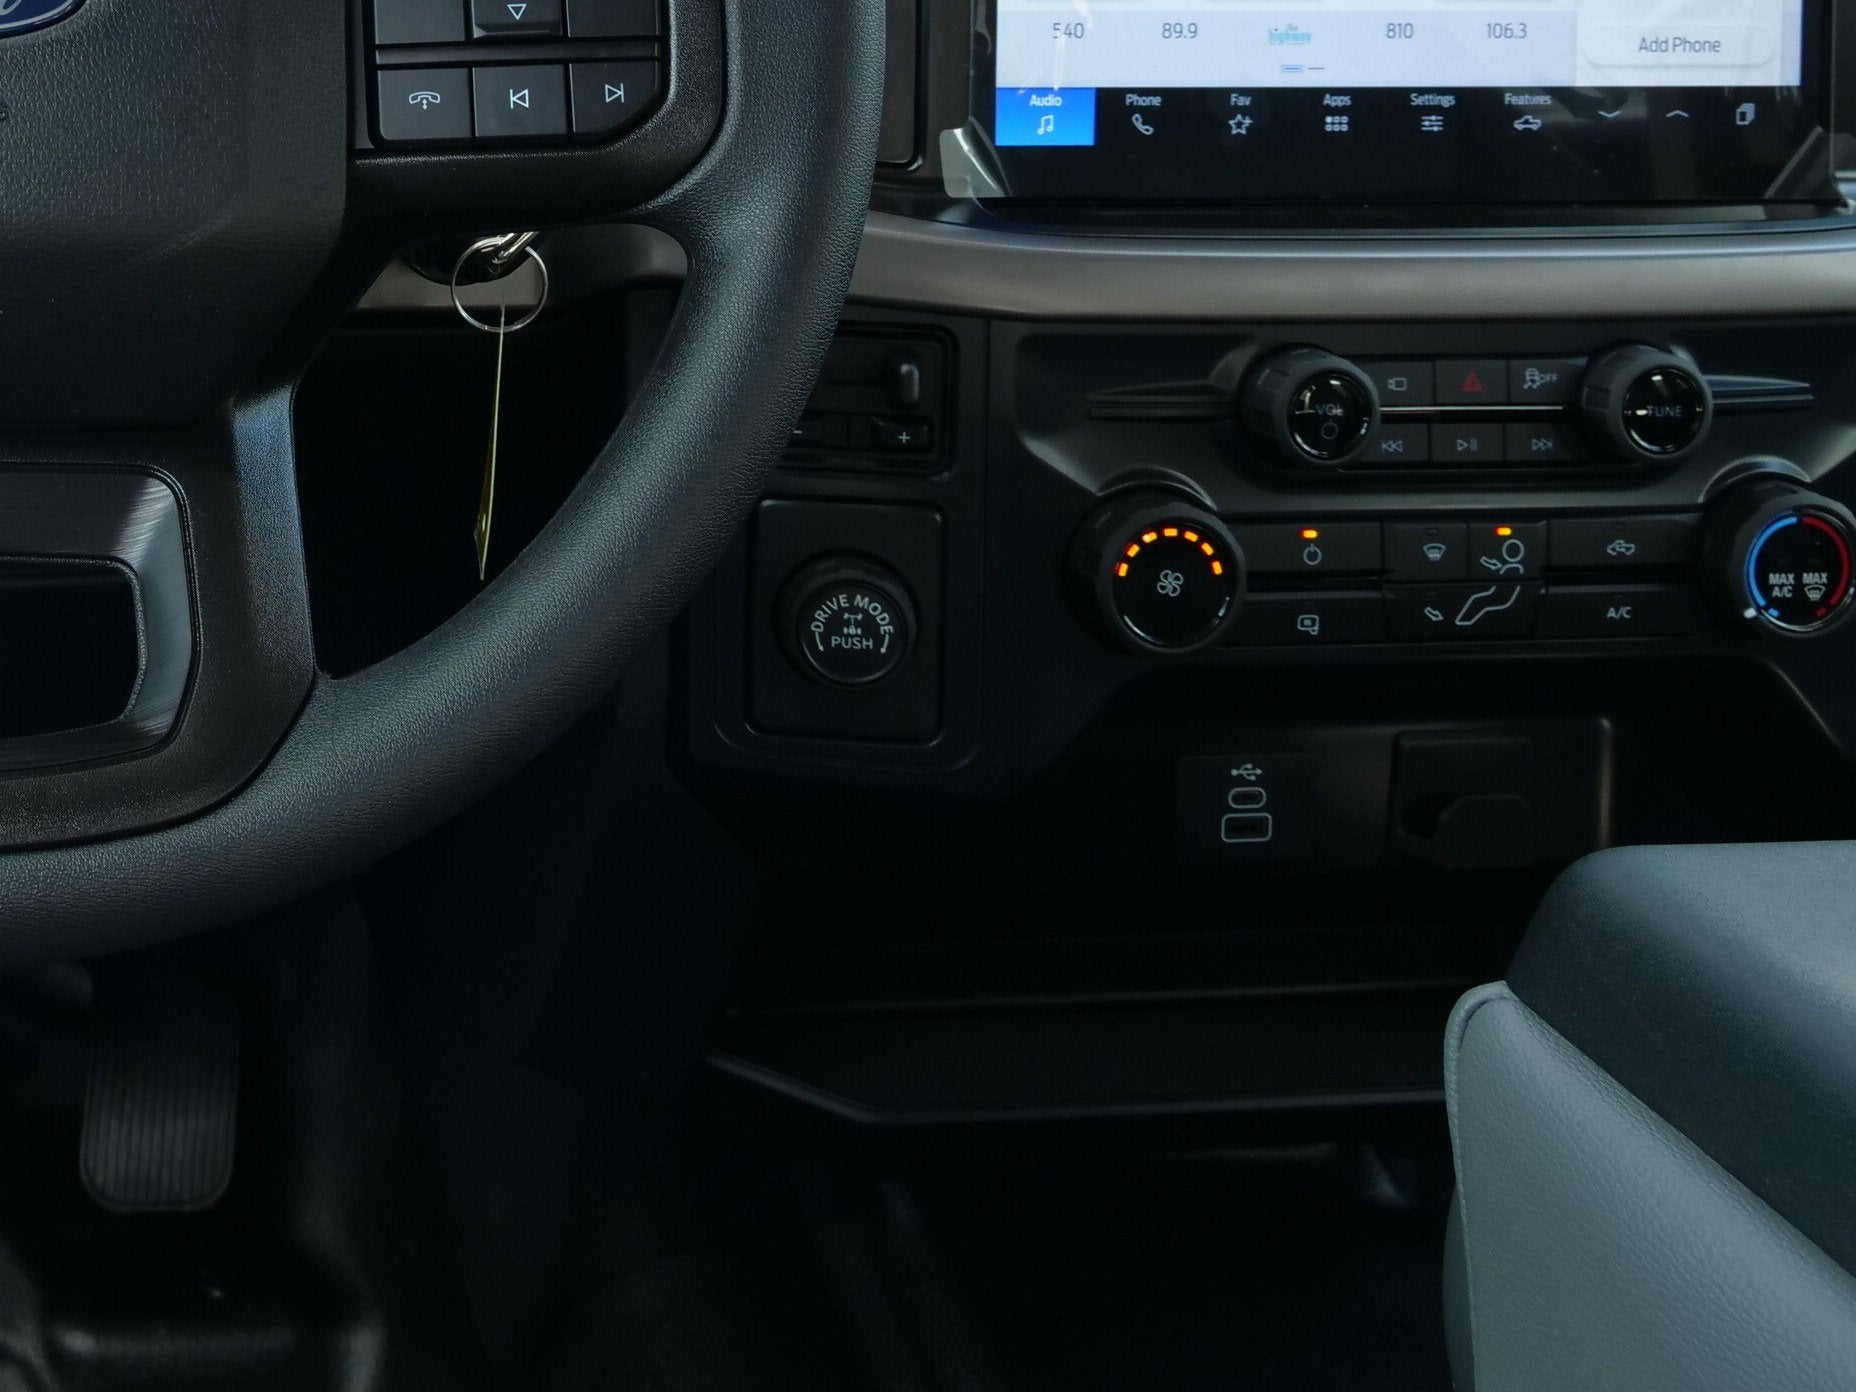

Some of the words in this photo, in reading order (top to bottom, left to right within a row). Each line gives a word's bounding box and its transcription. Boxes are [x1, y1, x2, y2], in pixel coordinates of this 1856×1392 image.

[1052, 23, 1085, 39] 540
[1162, 22, 1198, 39] 89.9
[1386, 23, 1414, 39] 810
[1486, 23, 1528, 39] 106.3
[1638, 37, 1669, 53] Add
[1672, 37, 1721, 54] Phone
[1029, 93, 1062, 106] Audio
[1125, 93, 1162, 106] Phone
[1230, 93, 1251, 106] Fav
[1323, 93, 1352, 108] Apps
[1410, 92, 1456, 107] Settings
[1503, 92, 1552, 105] Features
[1646, 405, 1683, 417] TUNE
[1768, 573, 1794, 585] MAX
[1802, 572, 1828, 584] MAX
[1772, 586, 1793, 597] A/C
[810, 593, 849, 634] DRIVE
[853, 593, 894, 635] MODE
[1606, 606, 1632, 619] A/C
[831, 636, 873, 650] PUSH
